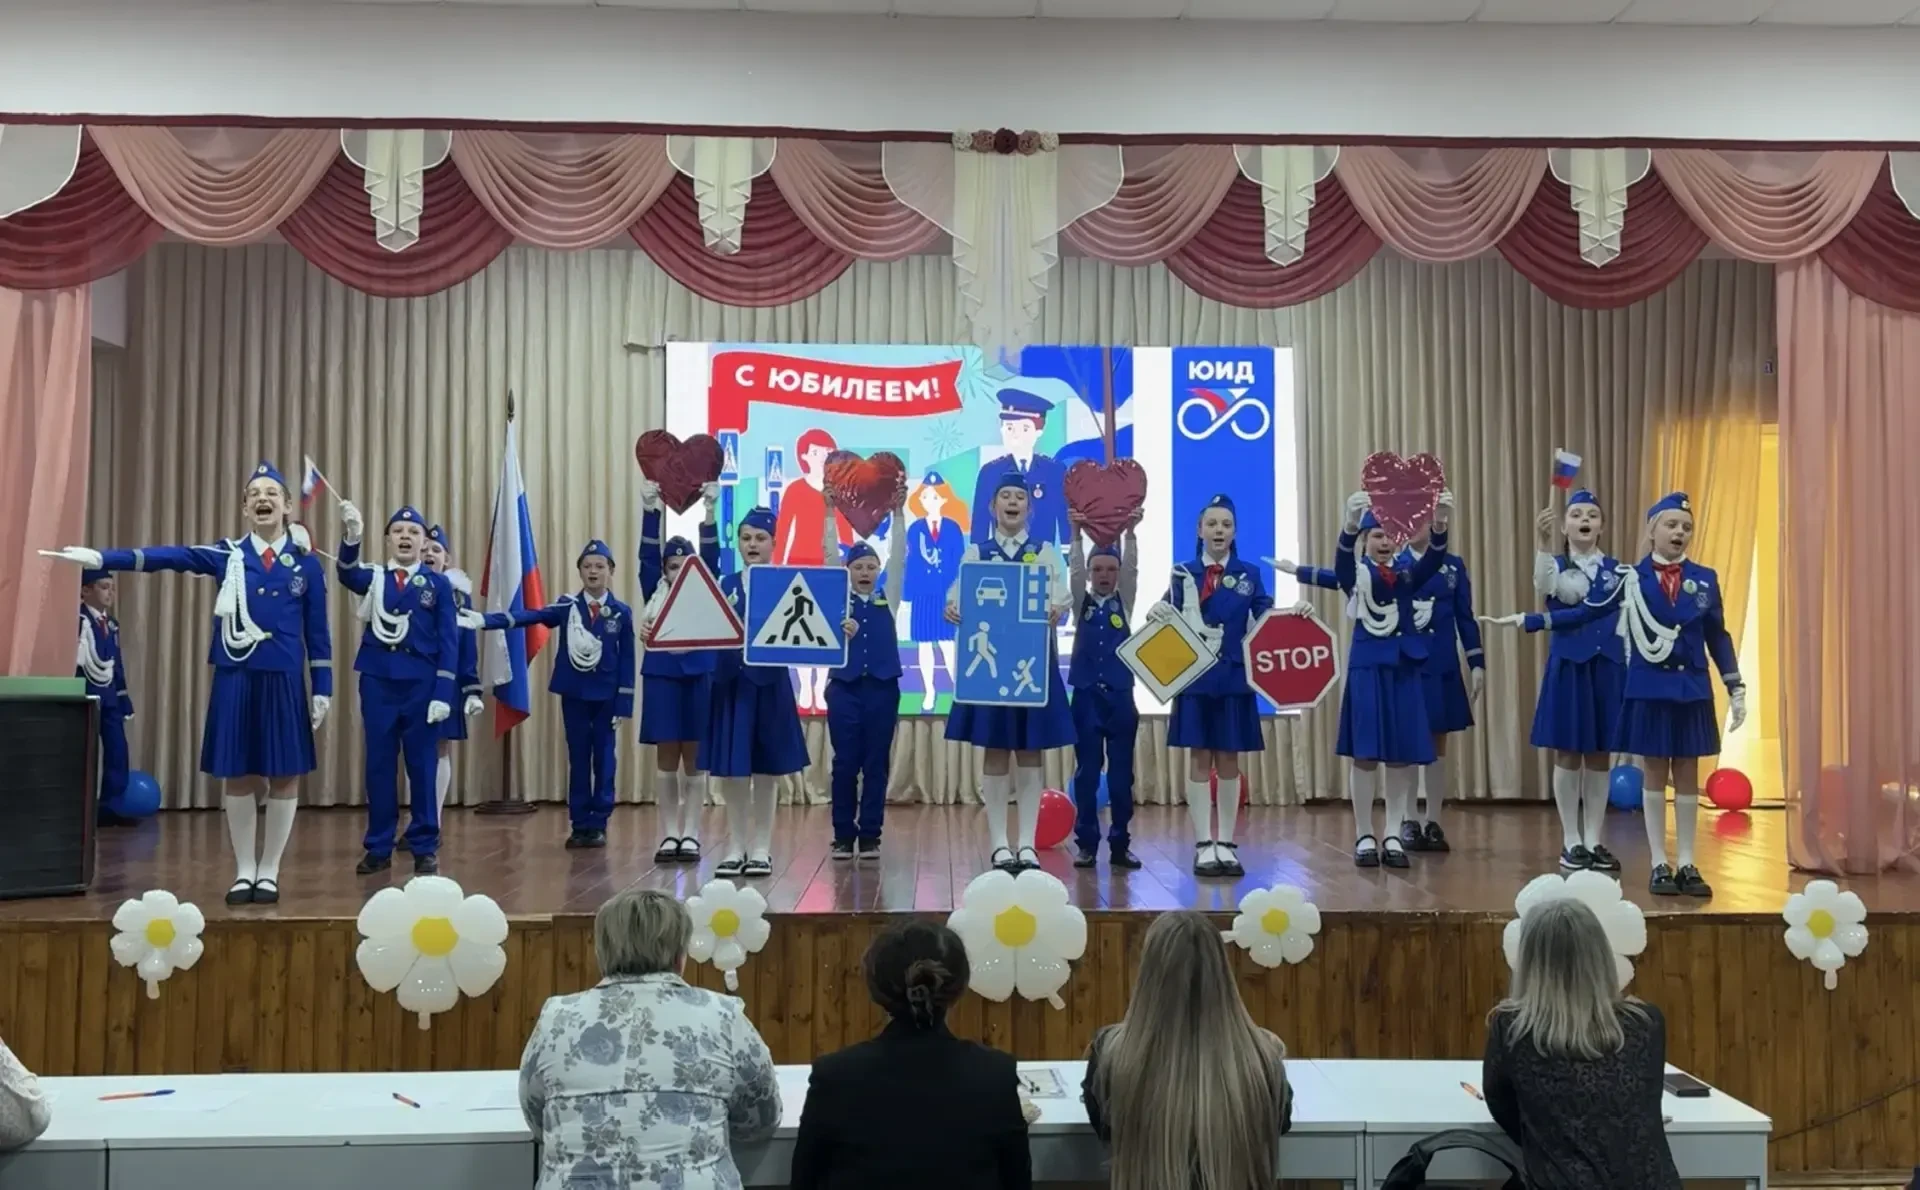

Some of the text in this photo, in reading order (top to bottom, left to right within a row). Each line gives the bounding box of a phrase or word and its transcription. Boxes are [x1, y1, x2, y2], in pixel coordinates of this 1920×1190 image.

[735, 365, 941, 402] С ЮБИЛЕЕМ!
[1189, 360, 1255, 384] ЮИД
[1256, 645, 1329, 673] STOP
